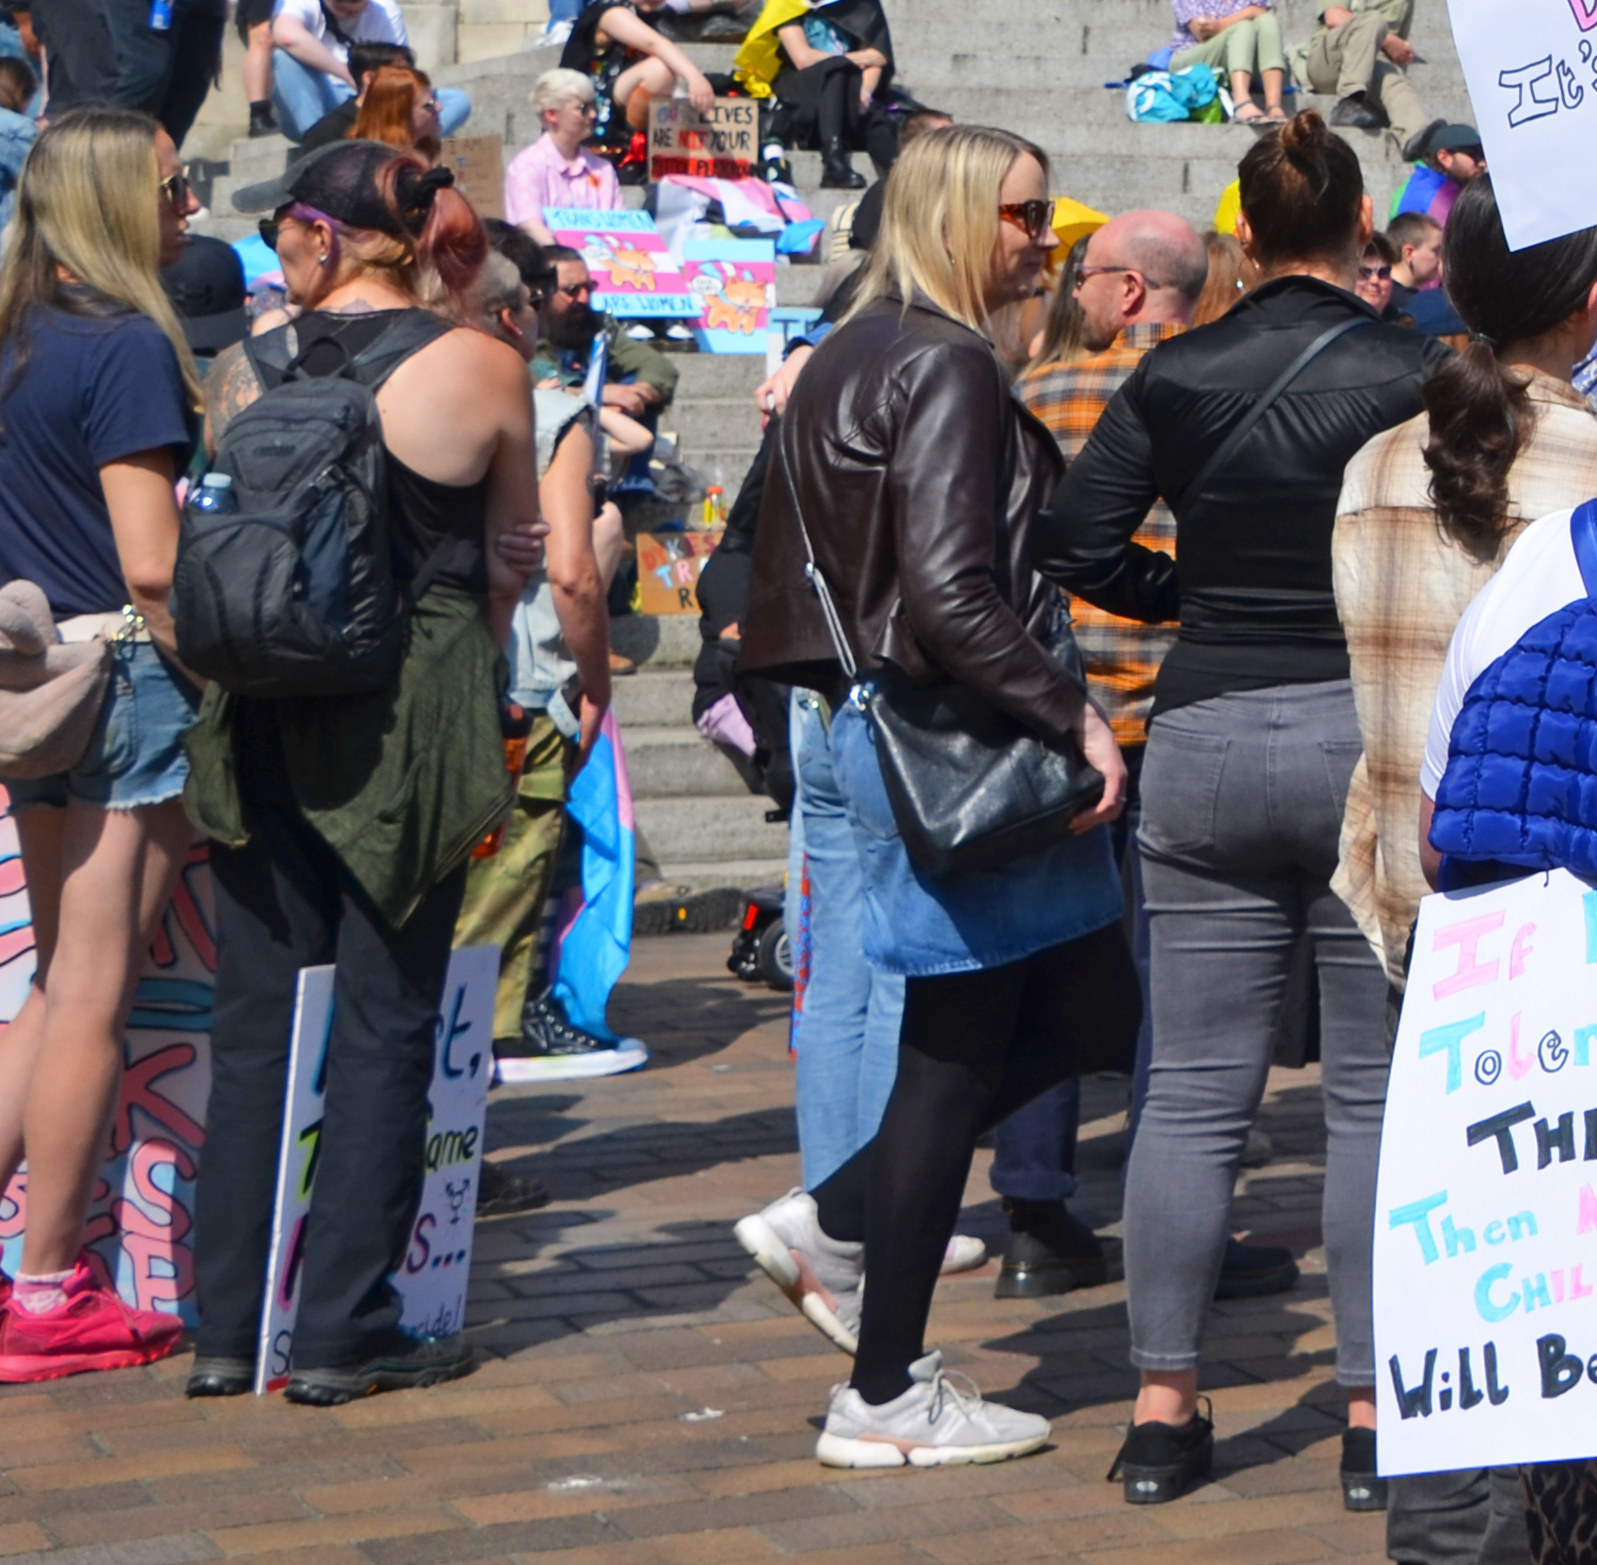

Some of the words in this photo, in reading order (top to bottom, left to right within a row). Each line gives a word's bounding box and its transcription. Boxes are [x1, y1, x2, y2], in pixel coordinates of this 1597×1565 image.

[1431, 908, 1537, 1002] If
[1388, 1189, 1538, 1267] Then
[1388, 1341, 1509, 1421] Will
